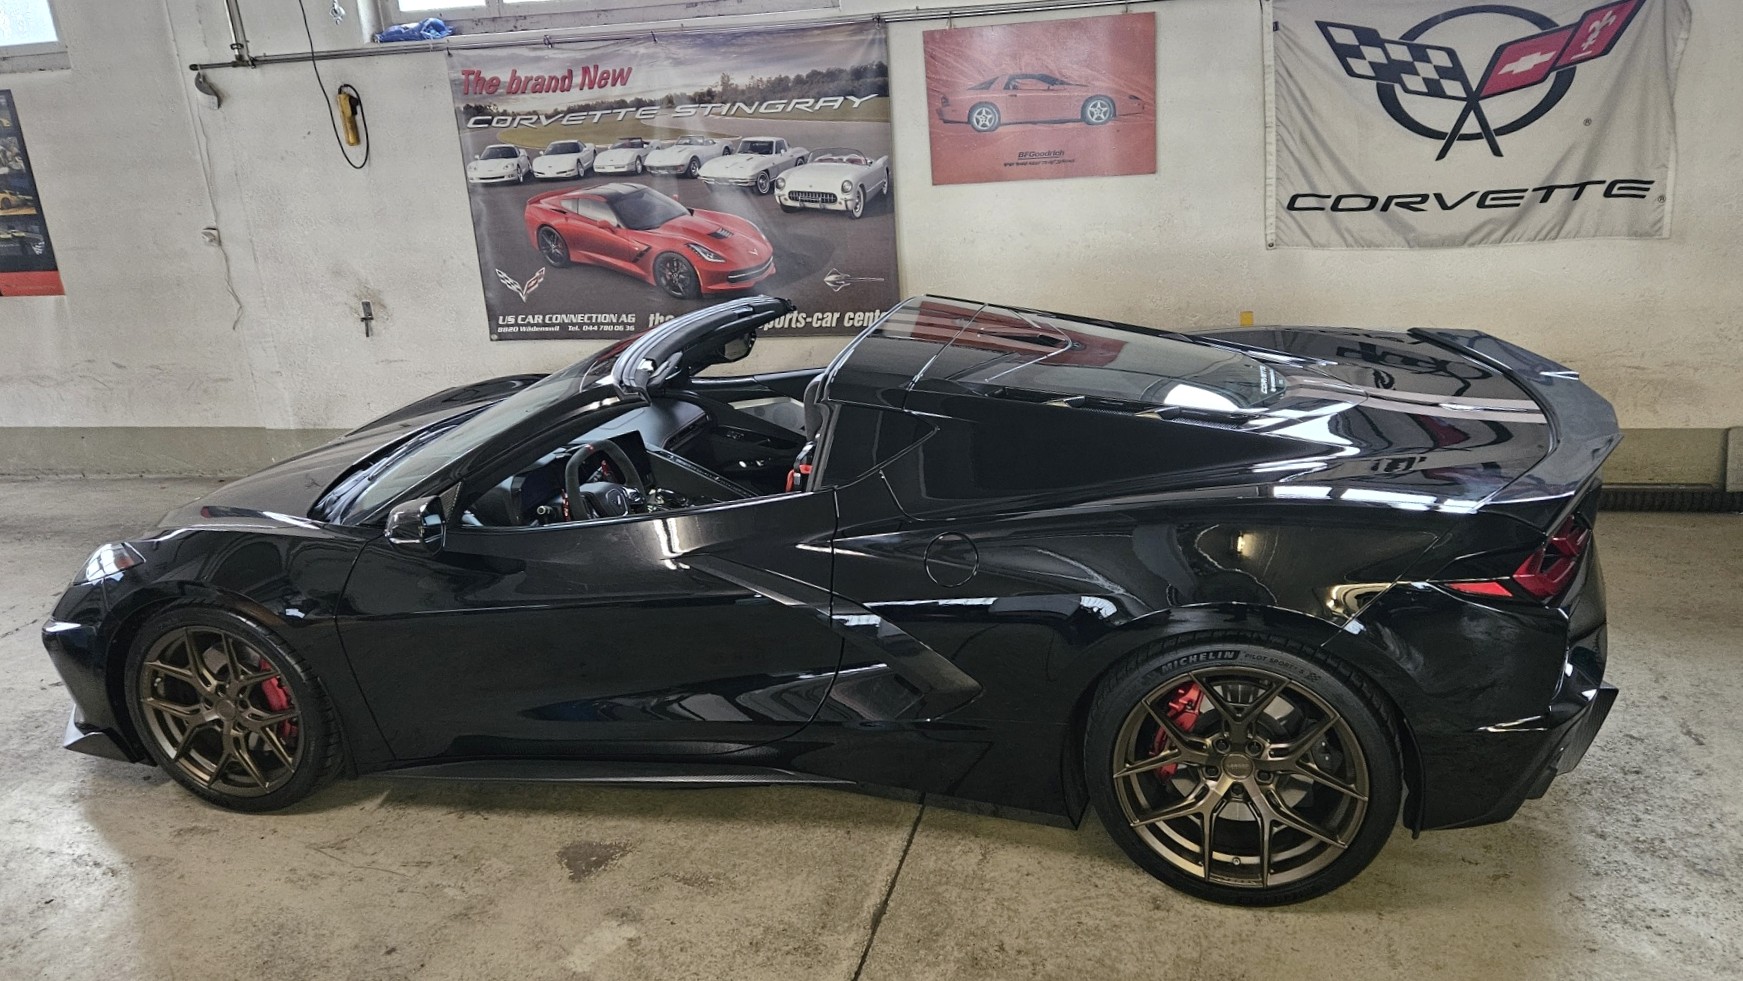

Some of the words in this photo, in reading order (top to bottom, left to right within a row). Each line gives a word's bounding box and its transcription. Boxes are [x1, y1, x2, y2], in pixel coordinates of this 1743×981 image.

[461, 69, 501, 95] The
[506, 69, 573, 95] brand
[579, 64, 632, 91] New
[466, 105, 661, 129] CORVETTE
[672, 93, 879, 118] STINGRAY
[1018, 150, 1065, 158] BFGoodrich
[1286, 179, 1655, 213] CORVETTE
[498, 315, 516, 325] US
[517, 314, 543, 324] CAR
[545, 313, 618, 324] CONNECTION
[618, 313, 636, 323] AG
[757, 310, 841, 331] ports-car
[844, 309, 887, 327] cent
[1161, 650, 1236, 673] MICHELIN
